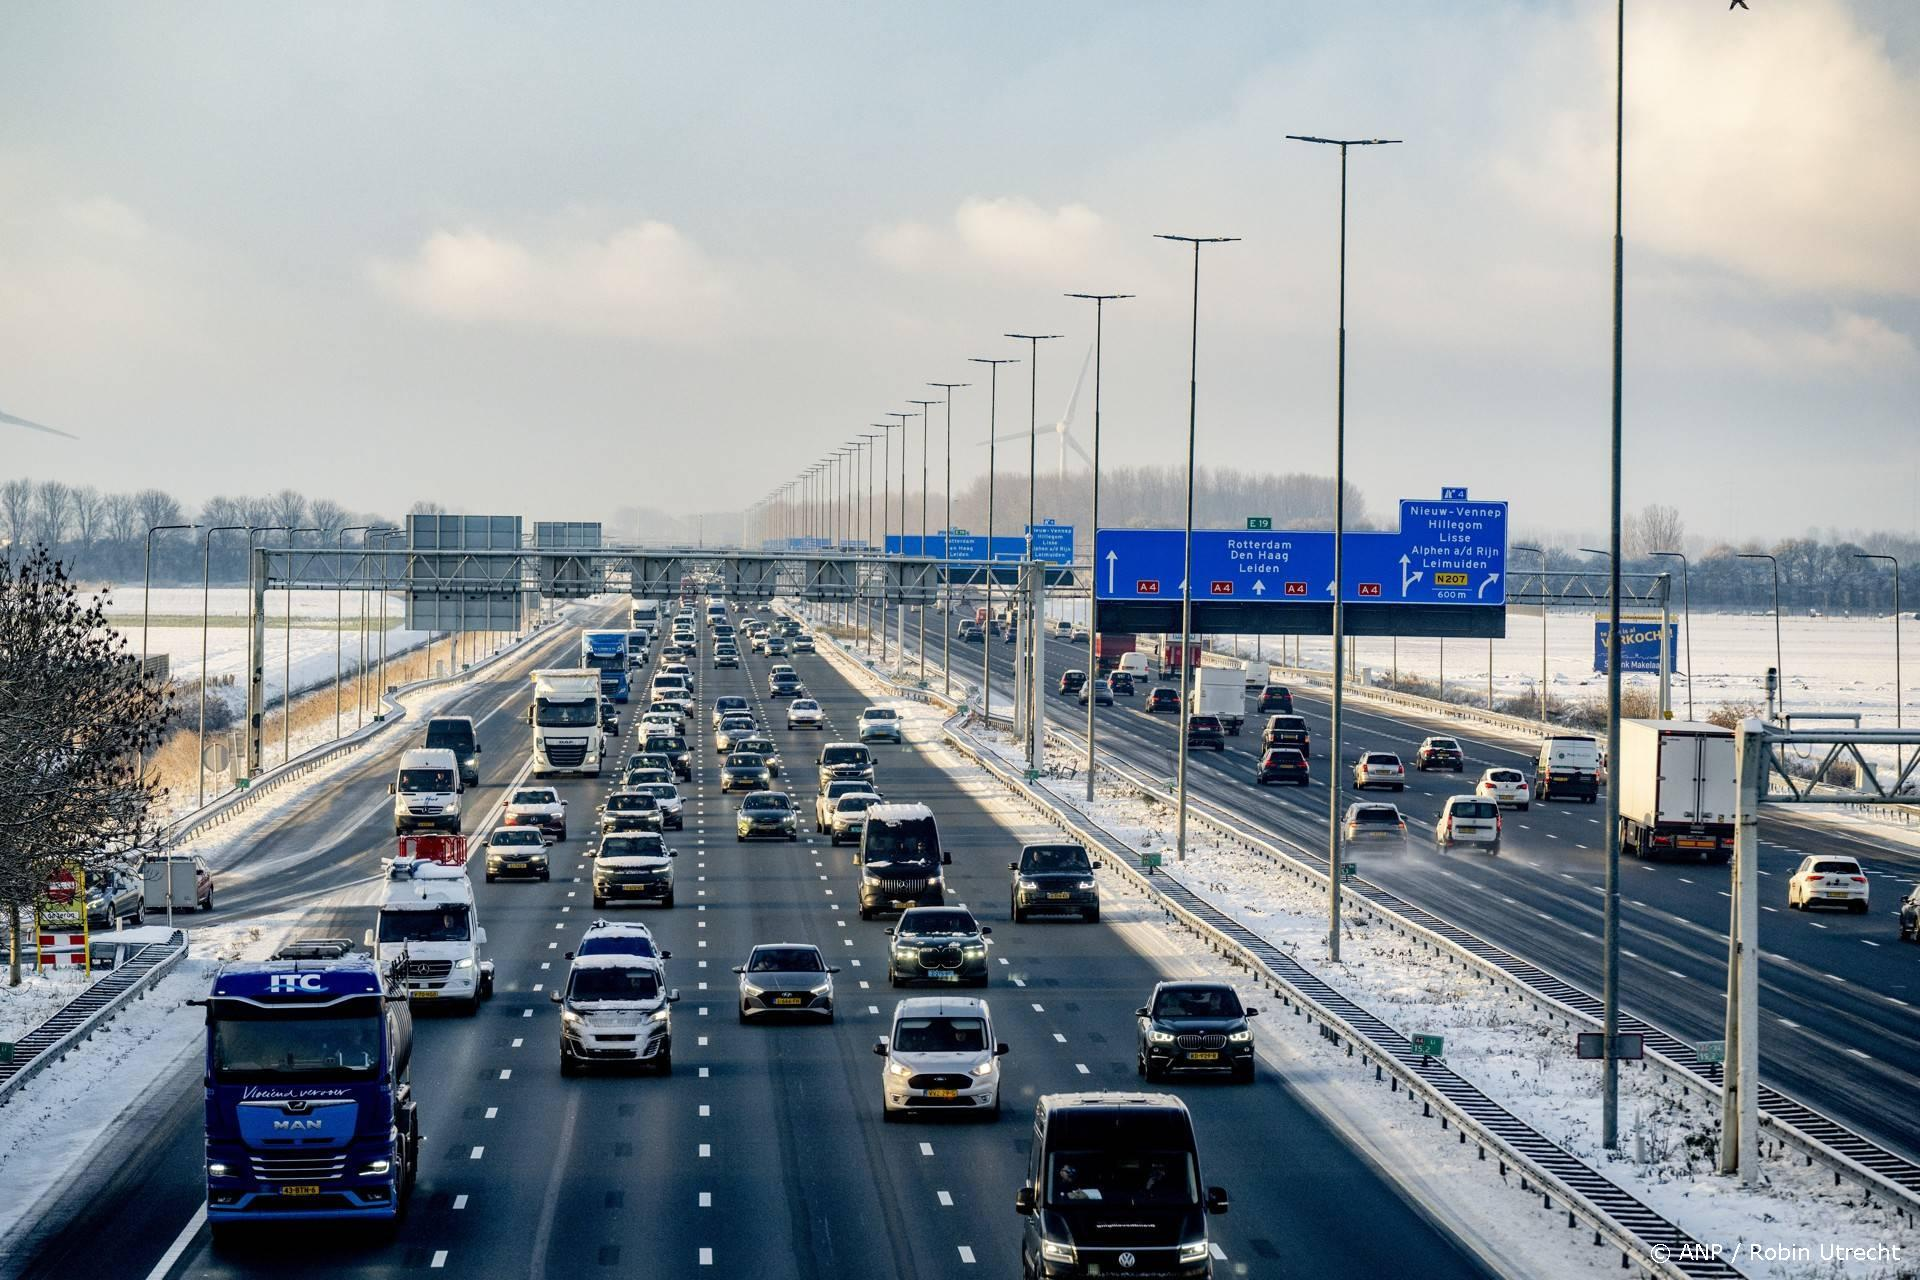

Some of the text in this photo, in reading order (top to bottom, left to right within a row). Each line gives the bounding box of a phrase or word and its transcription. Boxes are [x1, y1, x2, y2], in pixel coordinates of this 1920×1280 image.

[1410, 506, 1501, 518] Nieuw-Vennep
[1428, 520, 1482, 531] Hillegom
[1440, 533, 1471, 542] Lisse
[1228, 540, 1292, 549] Rotterdam
[1231, 551, 1289, 562] Den Haag
[1412, 546, 1499, 558] Alphen a/d Rijn
[1239, 564, 1280, 572] Leiden
[1423, 559, 1487, 569] Leimuiden
[271, 974, 320, 992] ITC
[273, 1120, 322, 1130] MAN
